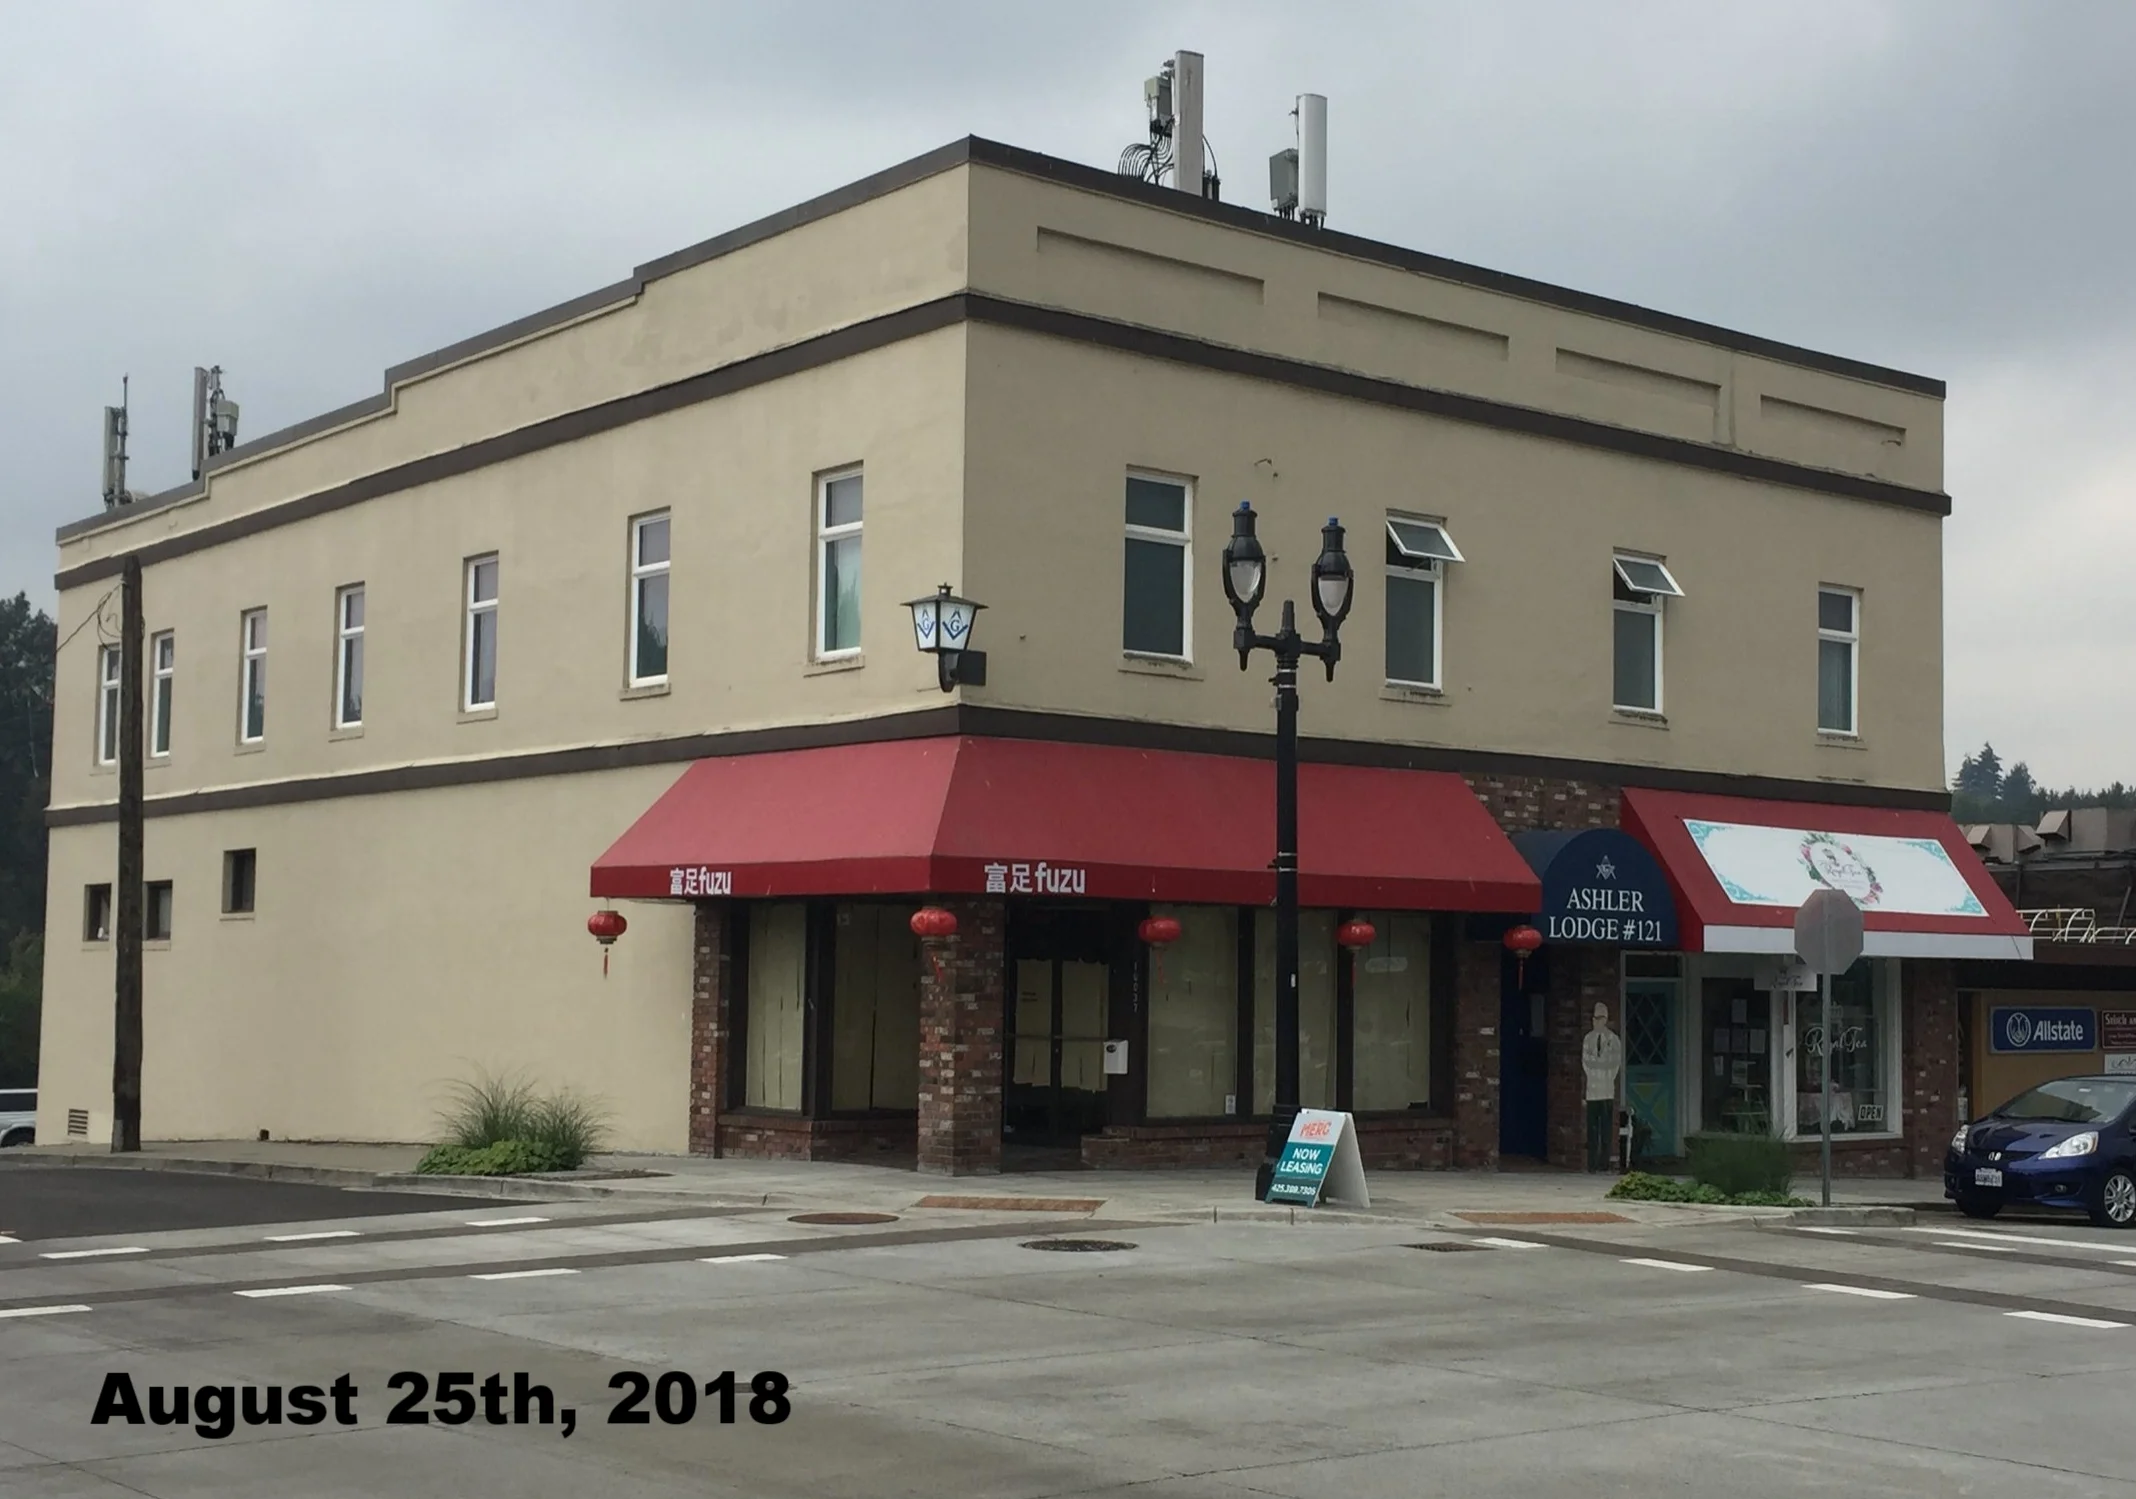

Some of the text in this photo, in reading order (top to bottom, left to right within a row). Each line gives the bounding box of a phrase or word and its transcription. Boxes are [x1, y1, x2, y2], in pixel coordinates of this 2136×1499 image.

[670, 866, 732, 895] 富足 fuzu
[983, 862, 1086, 893] 富足 fuzu
[1566, 887, 1645, 913] ASHLER
[1549, 915, 1662, 942] LODGE #121
[1805, 1026, 1869, 1057] Ryal Tea
[2033, 1020, 2084, 1041] Allstate
[1860, 1107, 1883, 1120] OPEN
[1292, 1147, 1321, 1161] NOW
[1280, 1160, 1324, 1175] LEASING
